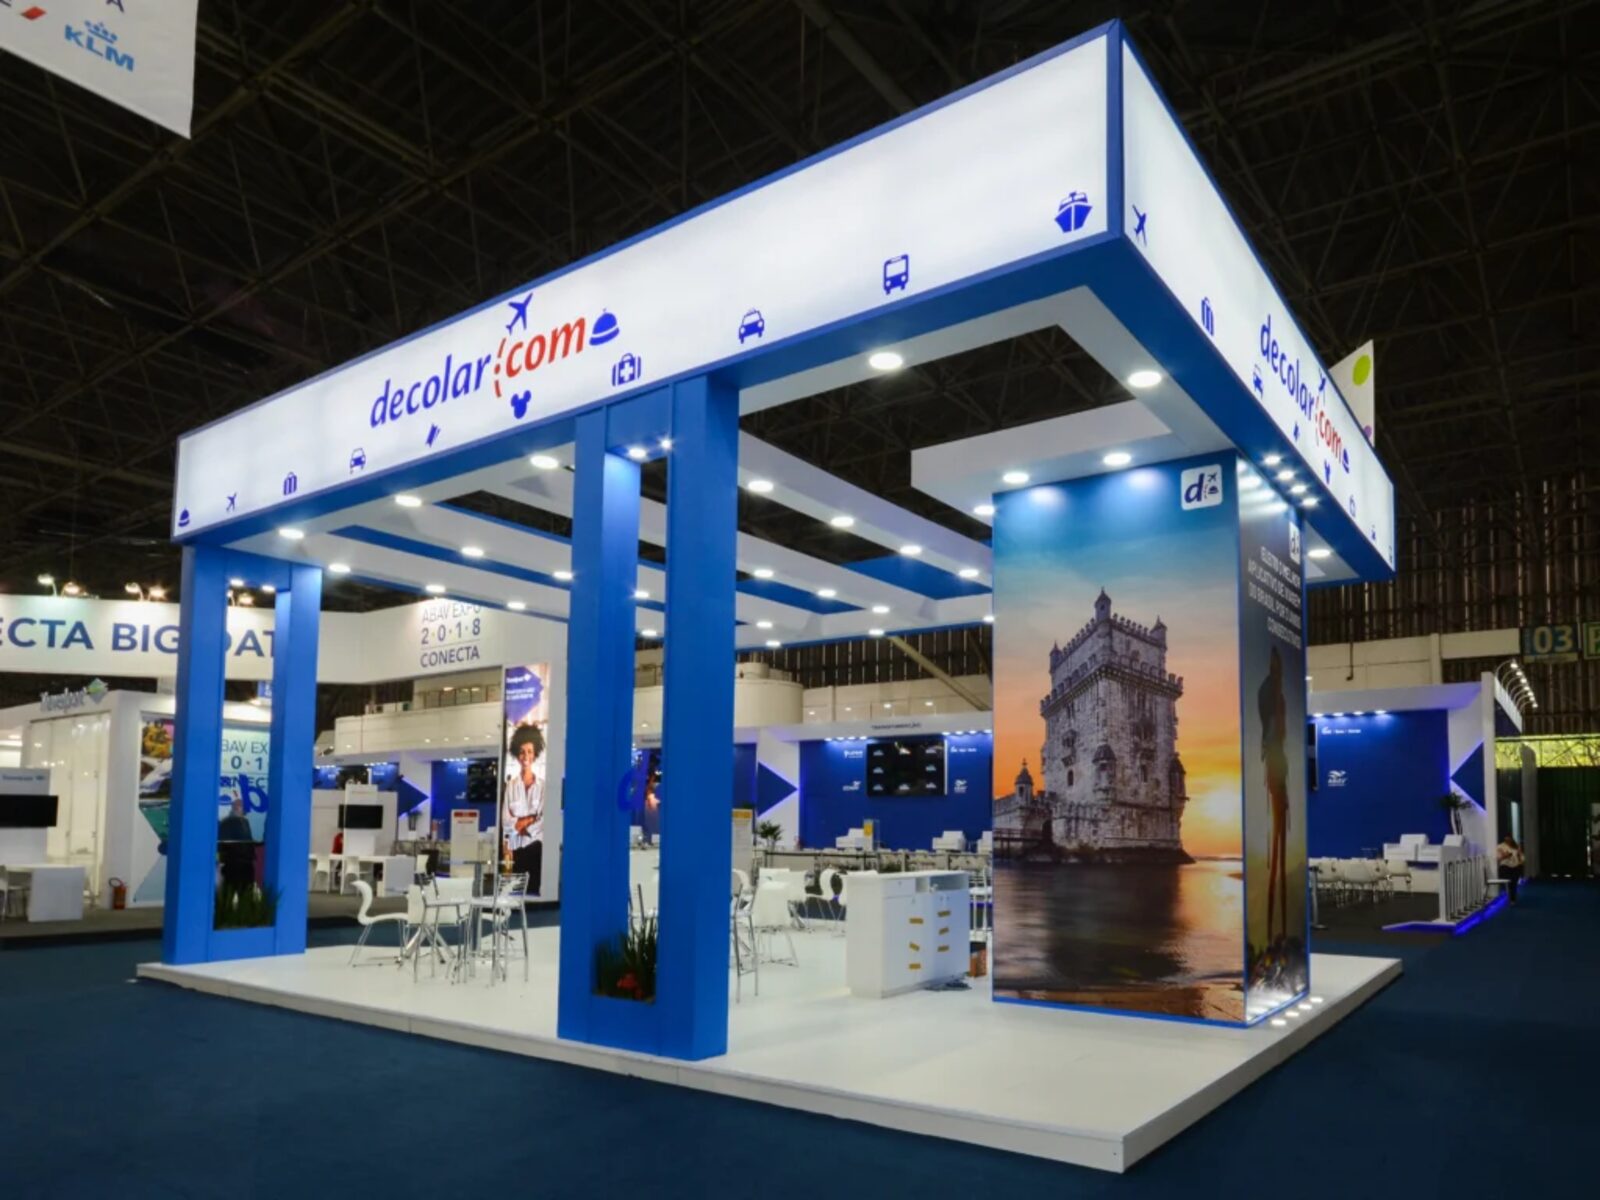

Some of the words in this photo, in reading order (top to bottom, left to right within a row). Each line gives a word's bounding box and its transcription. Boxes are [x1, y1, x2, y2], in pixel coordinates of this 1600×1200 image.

[64, 24, 135, 72] KLM
[1533, 625, 1573, 654] 03
[420, 645, 480, 668] CONECTA
[221, 739, 247, 753] BAV
[251, 741, 269, 754] EX
